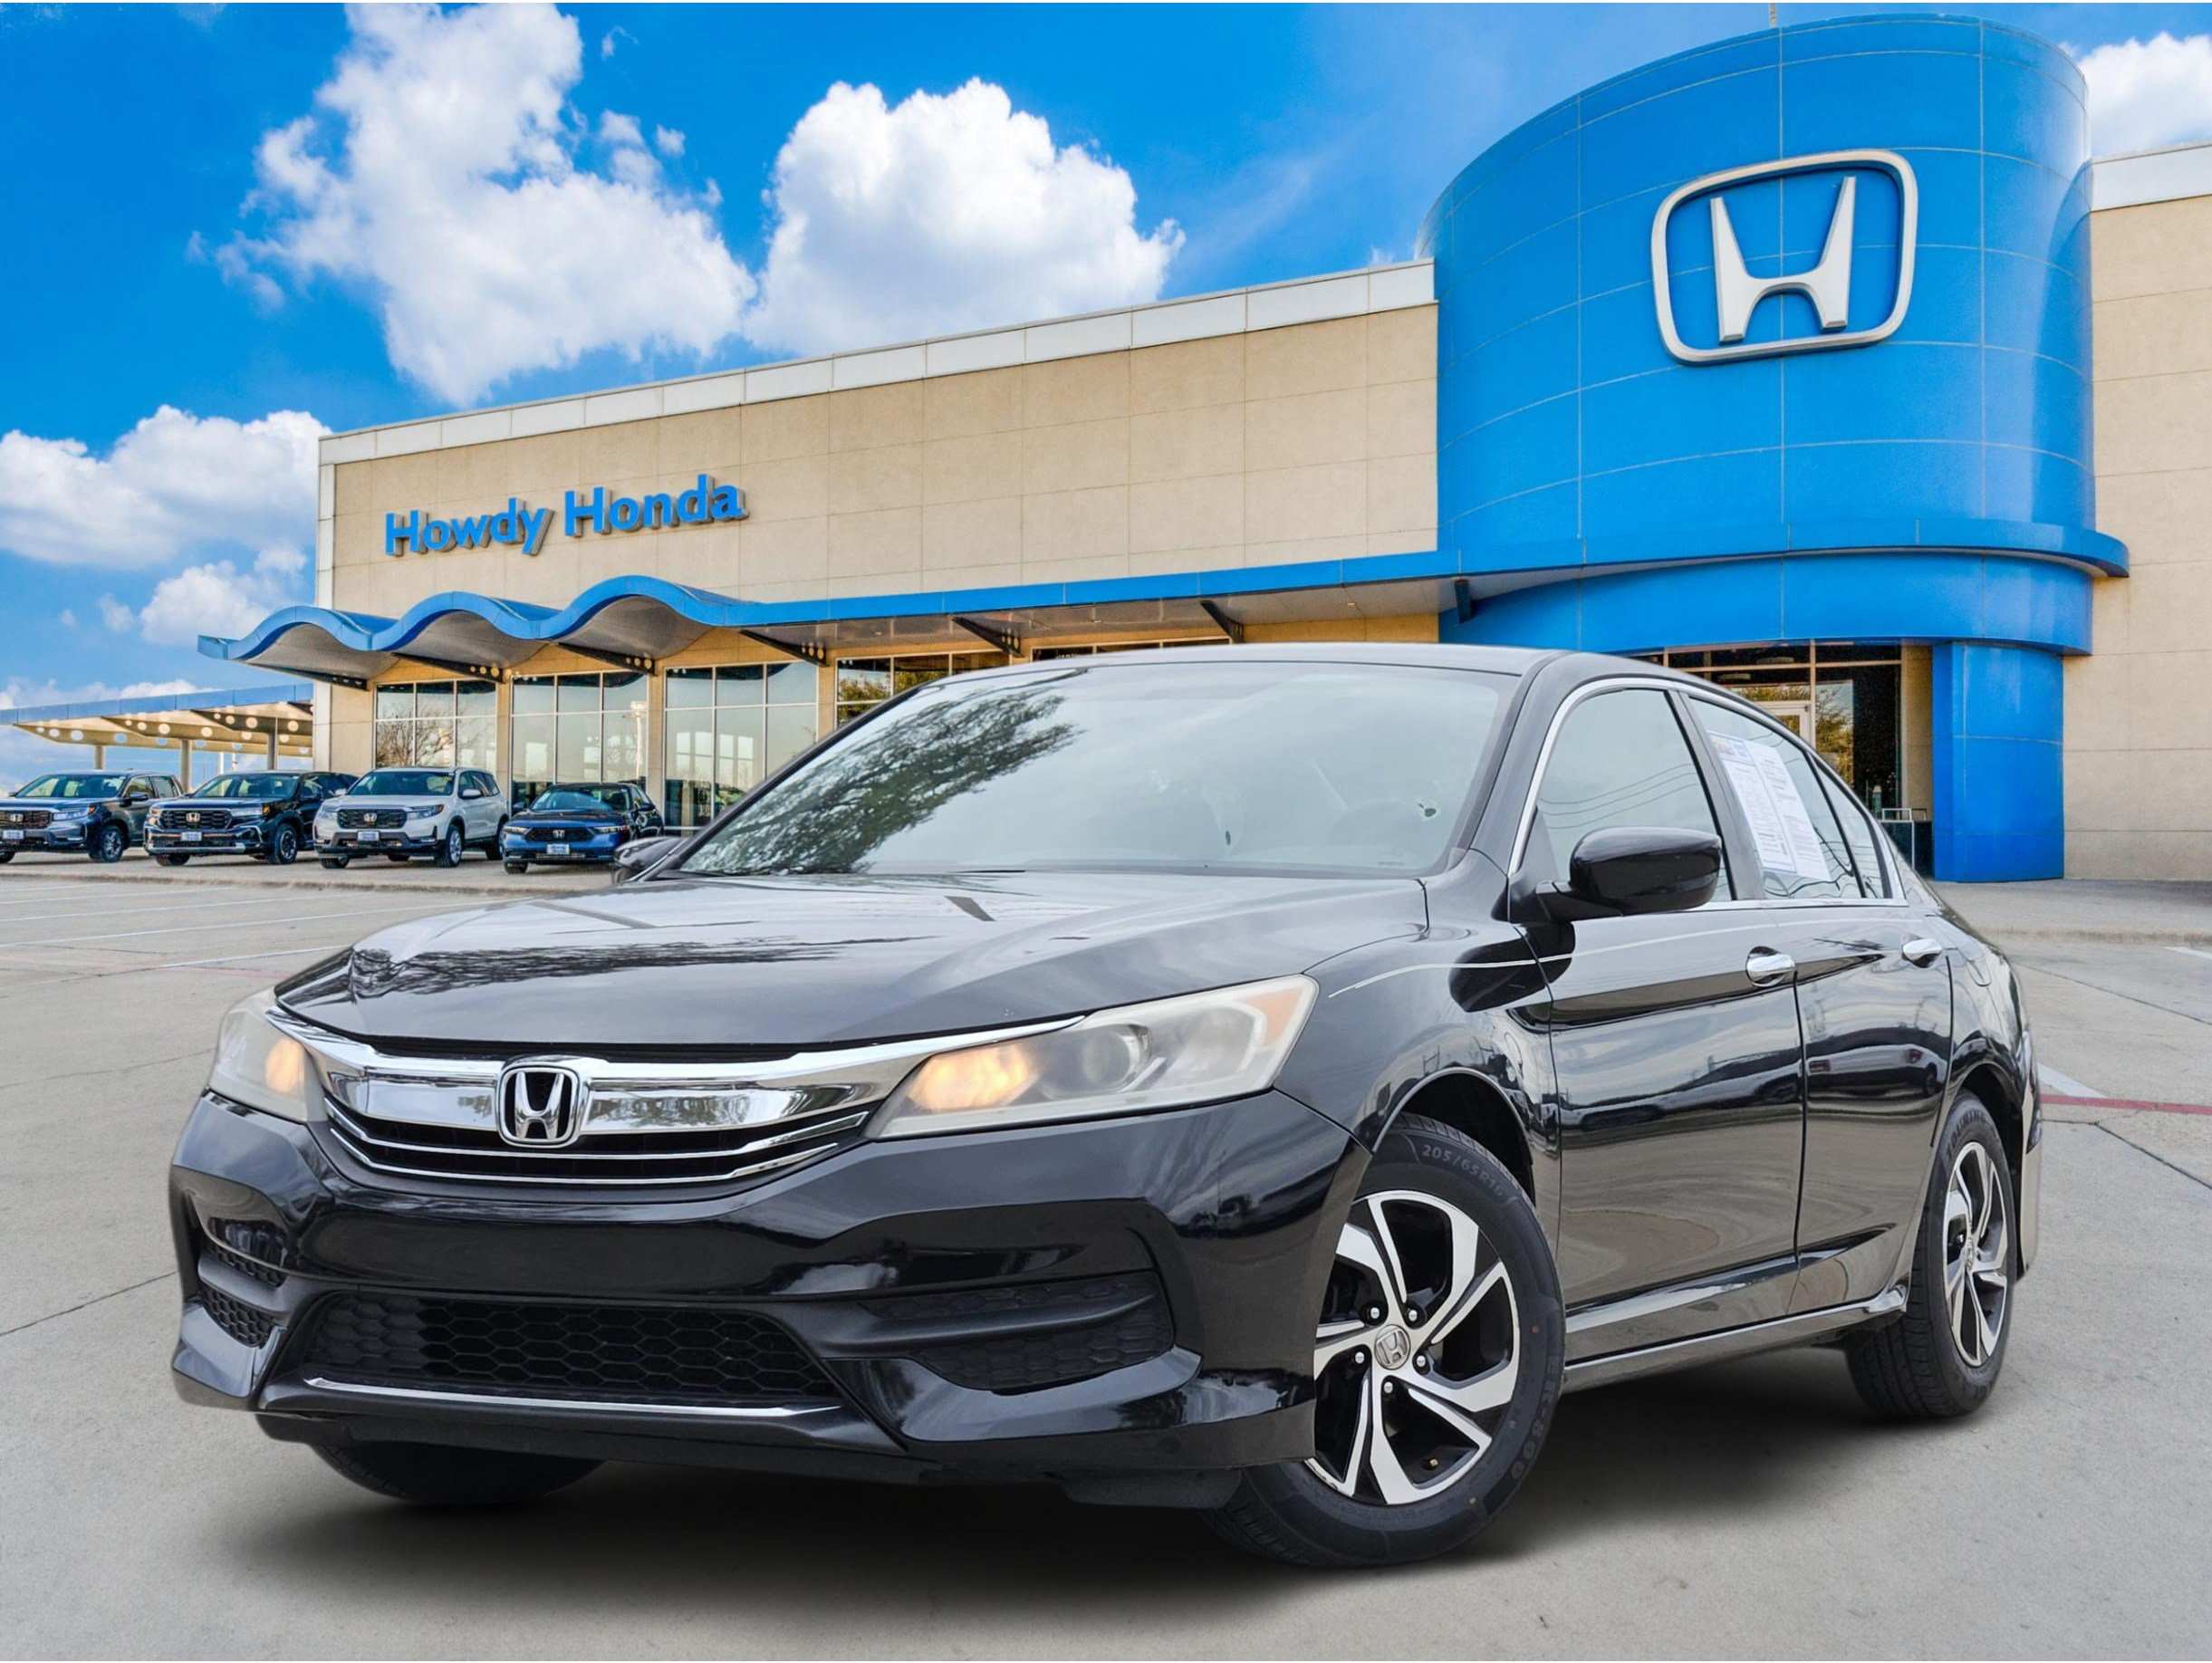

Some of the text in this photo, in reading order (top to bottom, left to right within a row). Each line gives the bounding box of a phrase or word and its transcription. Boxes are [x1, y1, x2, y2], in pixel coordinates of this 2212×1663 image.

[385, 474, 749, 556] Howdy Honda
[1421, 1144, 1504, 1197] 205/65R16
